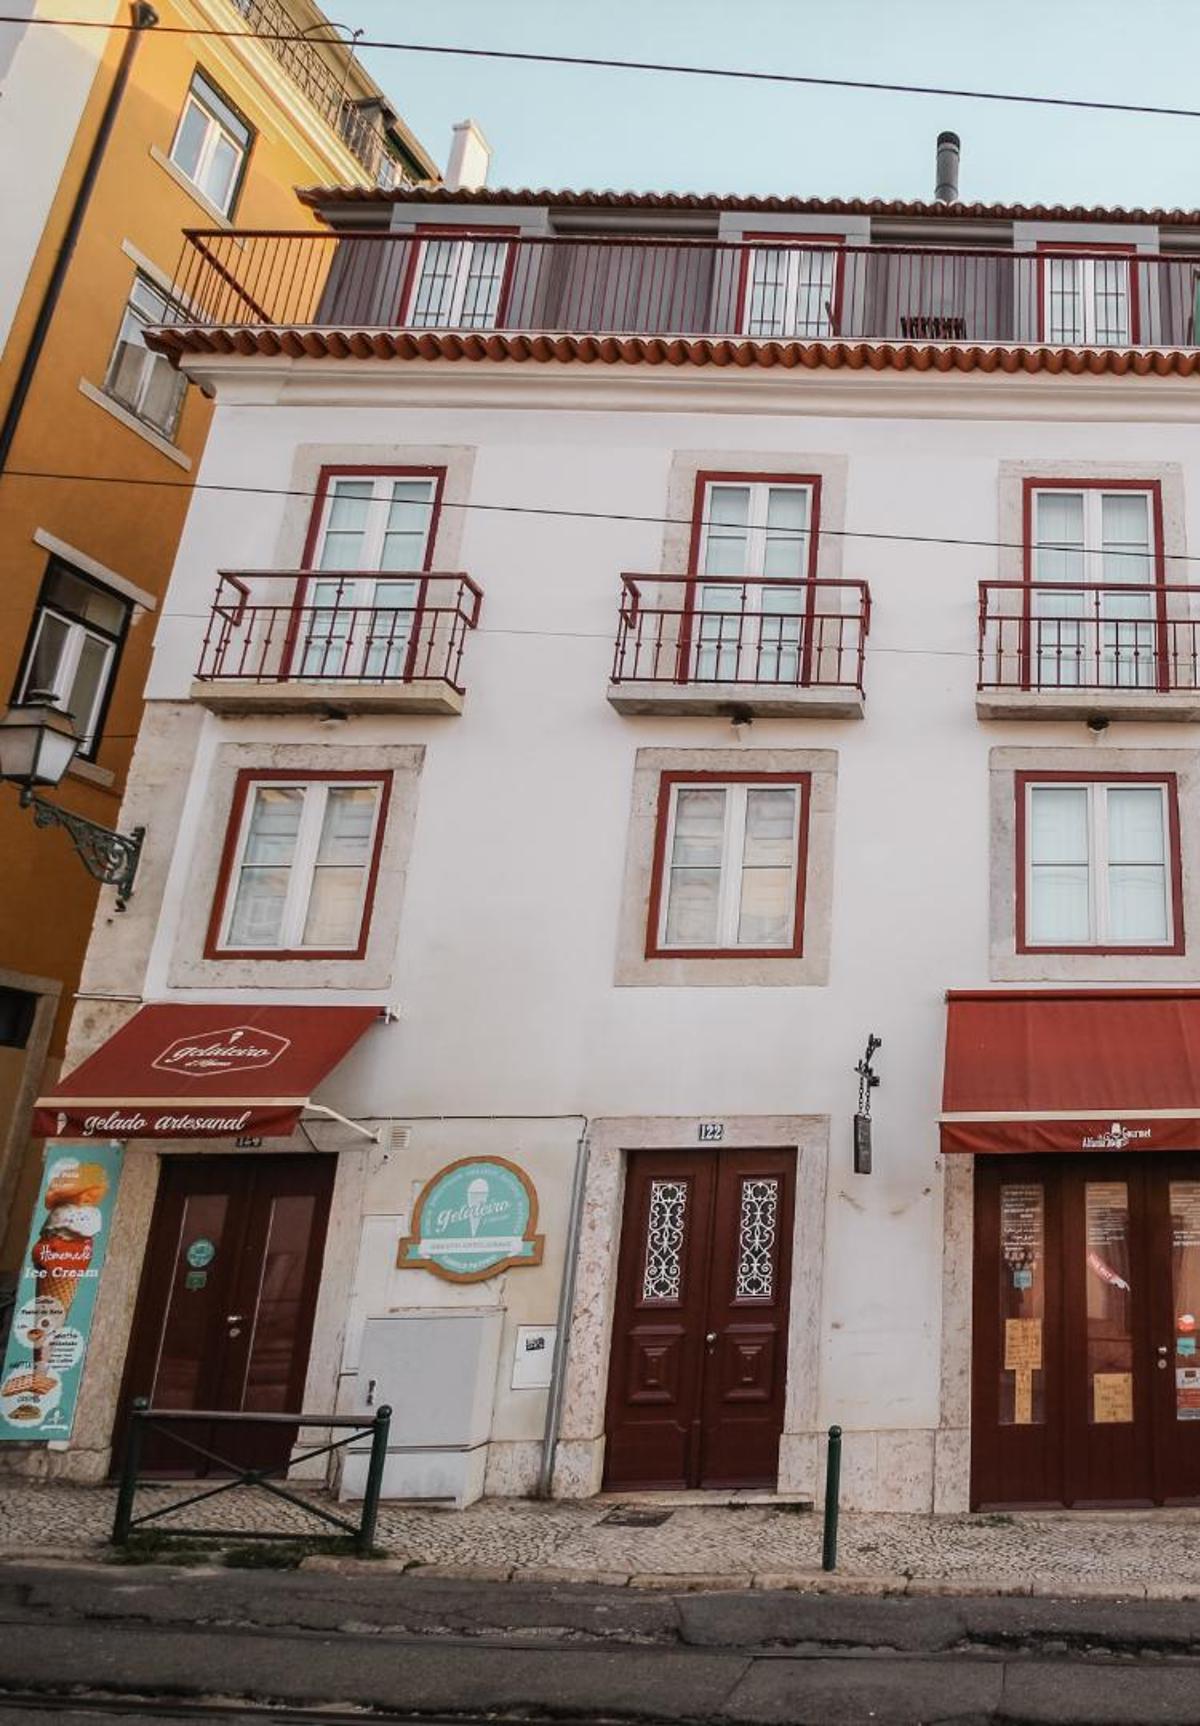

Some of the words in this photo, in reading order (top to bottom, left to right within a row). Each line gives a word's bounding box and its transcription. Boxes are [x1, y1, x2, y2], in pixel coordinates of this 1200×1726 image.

[83, 1111, 147, 1136] gelado
[154, 1111, 252, 1131] artesanal
[701, 1125, 722, 1140] 122
[25, 1267, 48, 1279] Ice
[52, 1266, 99, 1278] Cream
